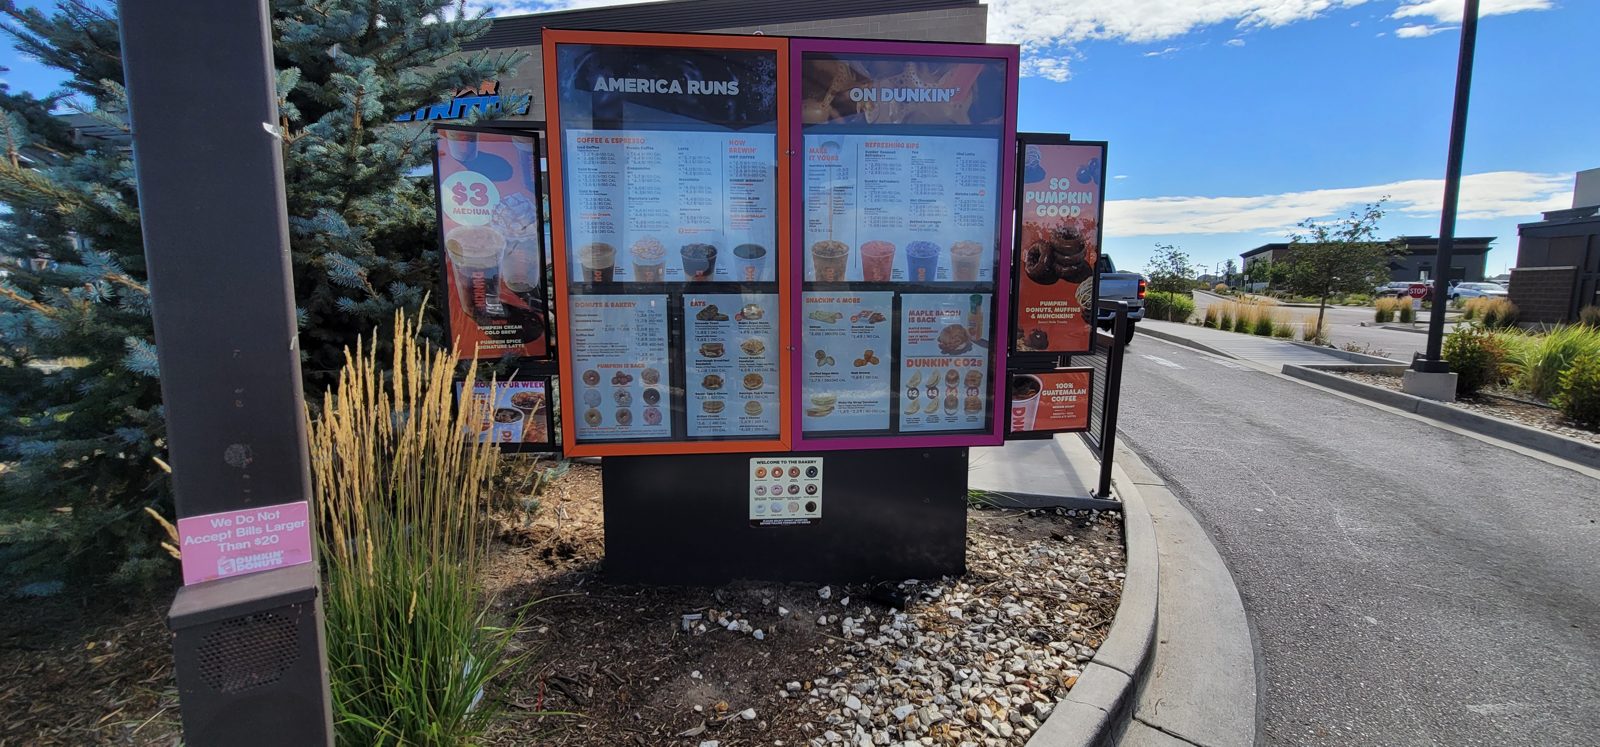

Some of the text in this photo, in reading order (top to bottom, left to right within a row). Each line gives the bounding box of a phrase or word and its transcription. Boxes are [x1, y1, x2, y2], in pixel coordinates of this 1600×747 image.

[593, 76, 740, 95] AMERICA RUNS
[849, 87, 956, 102] ON DUNKIN'
[1049, 177, 1070, 191] SO
[451, 181, 490, 207] $3
[1025, 191, 1093, 205] PUMPKIN
[452, 207, 490, 216] MEDIUM
[1035, 204, 1081, 217] GOOD
[906, 359, 952, 367] DUNKIN'
[210, 510, 281, 529] We Do Not
[184, 520, 306, 546] Accept Bills Larger
[218, 534, 279, 552] Than $20
[235, 557, 284, 571] DONUTS
